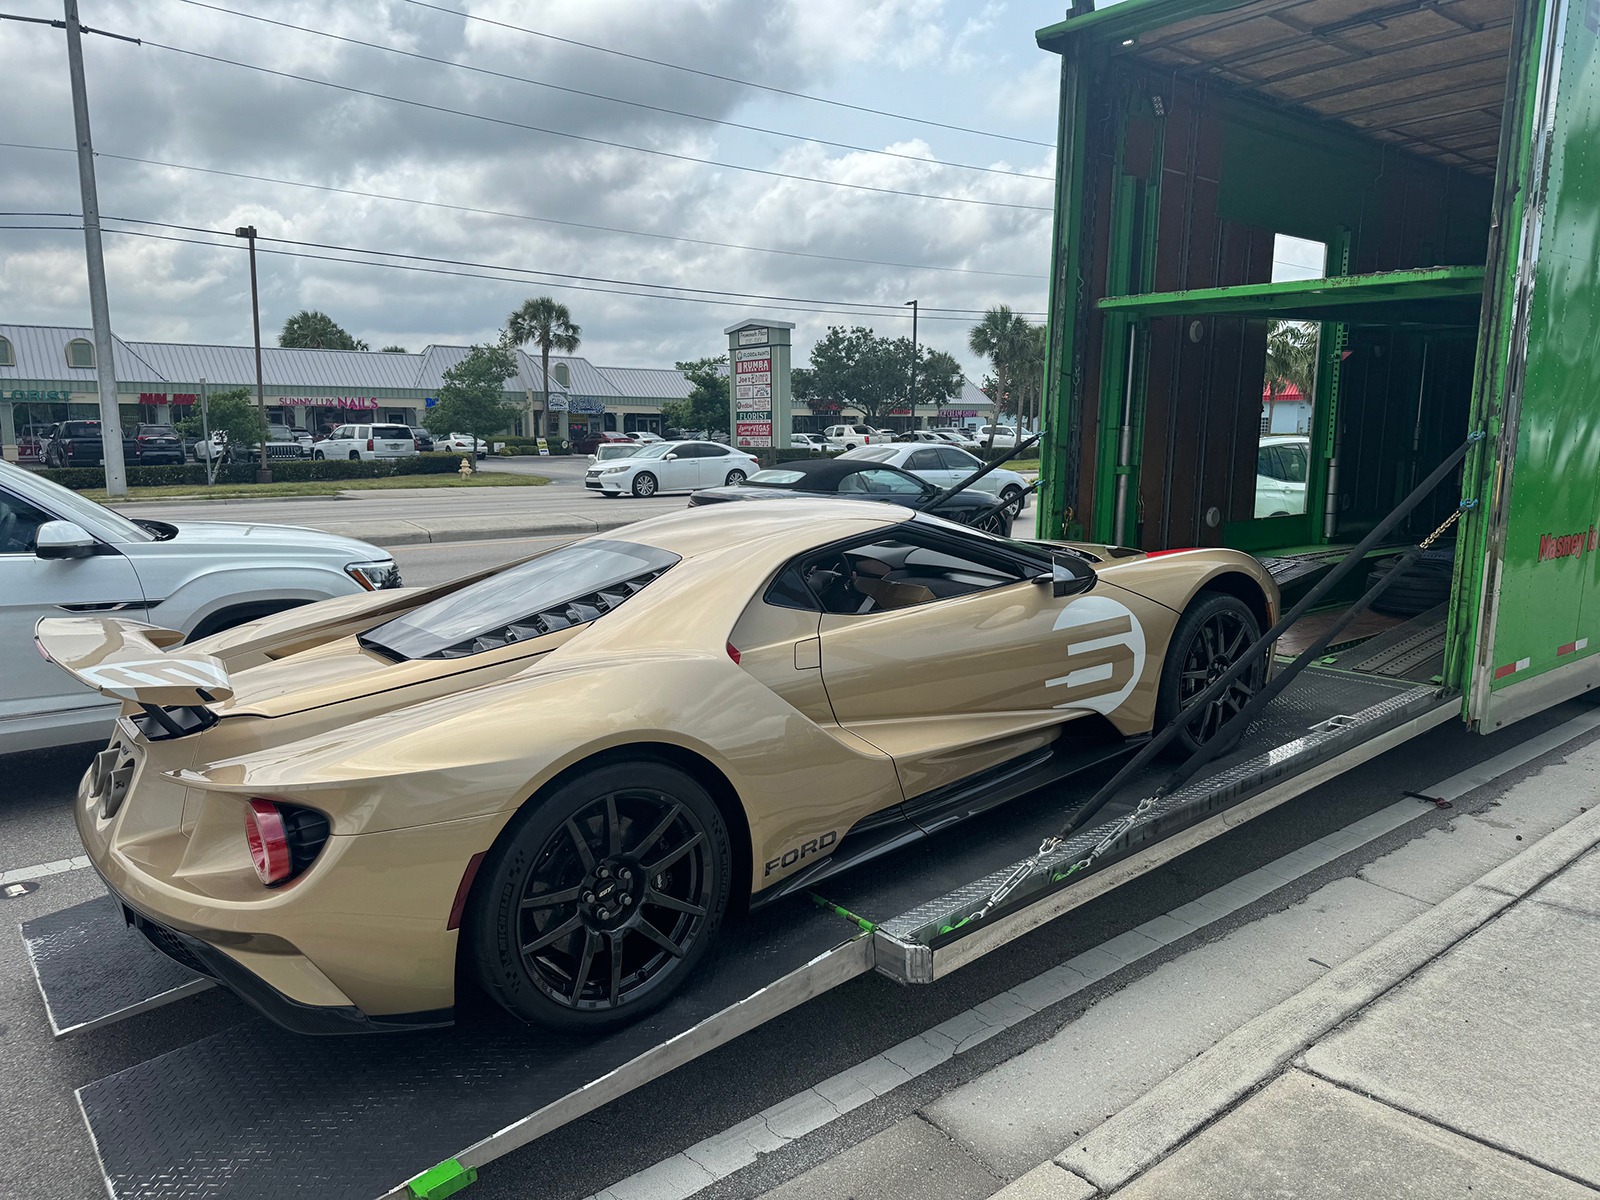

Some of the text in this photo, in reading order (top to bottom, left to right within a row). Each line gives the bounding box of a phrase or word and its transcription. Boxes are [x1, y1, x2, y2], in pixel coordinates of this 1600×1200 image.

[742, 360, 769, 369] RUMBA
[738, 376, 750, 384] Joe's
[278, 396, 379, 411] SUNNY LUX NAILS
[739, 412, 768, 420] FLORIST
[753, 424, 770, 432] VEGAS
[1537, 524, 1598, 563] Masney is
[764, 830, 837, 878] FORD
